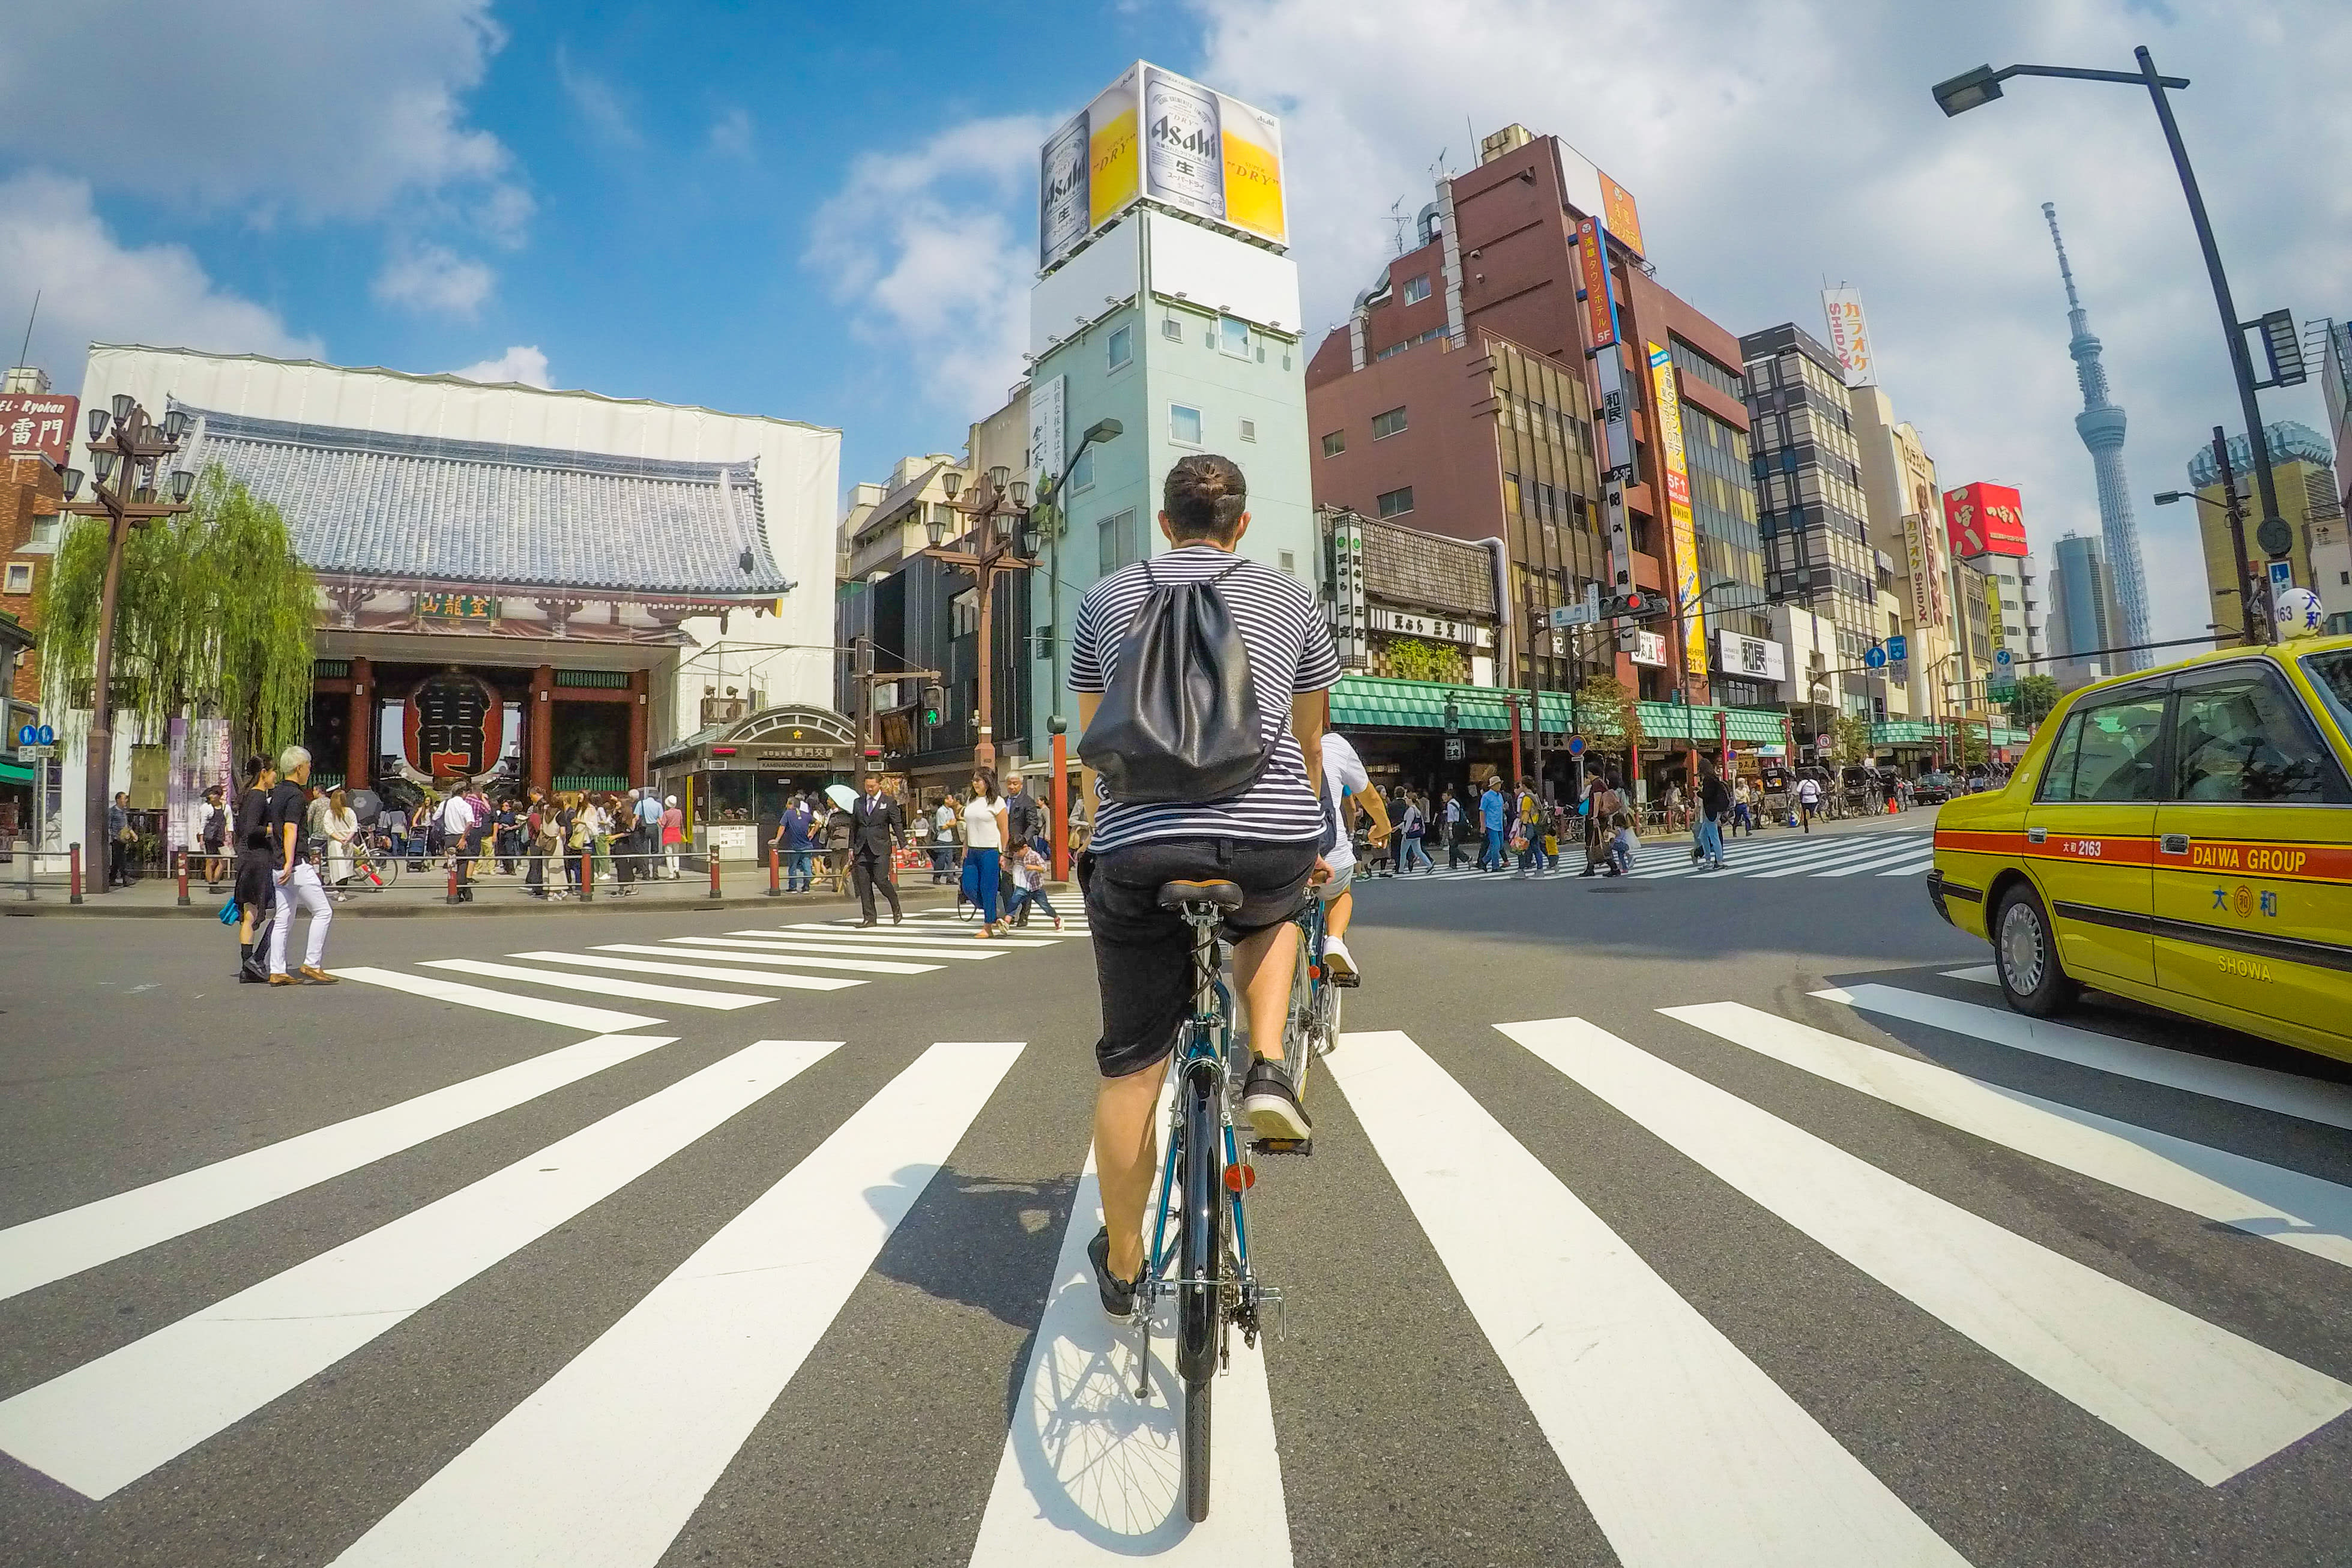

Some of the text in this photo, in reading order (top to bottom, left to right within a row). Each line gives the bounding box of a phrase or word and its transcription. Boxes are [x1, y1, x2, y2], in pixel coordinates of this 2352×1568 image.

[1256, 115, 1275, 127] Asahi
[1151, 115, 1216, 160] Asahi
[1045, 152, 1086, 211] Asahi
[1167, 172, 1205, 190] スーパードライ
[1176, 160, 1195, 177] 生
[1058, 206, 1070, 225] 生
[1583, 236, 1608, 329] 浅草タウンホテル
[1597, 329, 1611, 342] 5F
[1829, 303, 1854, 371] SHIDAX
[1842, 301, 1869, 371] カラオケ
[21, 400, 65, 415] Ryokan
[1606, 391, 1622, 422] 和民
[1613, 467, 1632, 481] 2-3F
[1668, 473, 1680, 489] 5F
[1906, 519, 1922, 570] カラオケ
[1337, 552, 1348, 592] 天ぷら
[1352, 555, 1362, 594] 天ぷら
[1914, 572, 1928, 623] SHIDAX
[2302, 592, 2321, 631] 大和
[1395, 615, 1424, 633] 天ぷら
[2275, 605, 2293, 623] 163
[1656, 638, 1664, 651] 1F
[1742, 641, 1767, 671] 和民
[414, 681, 492, 776] 雷門
[794, 747, 834, 758] 雷門交番
[2078, 840, 2102, 857] 2163
[2194, 846, 2306, 872] DAIWA GROUP
[2218, 954, 2274, 984] SHOWA
